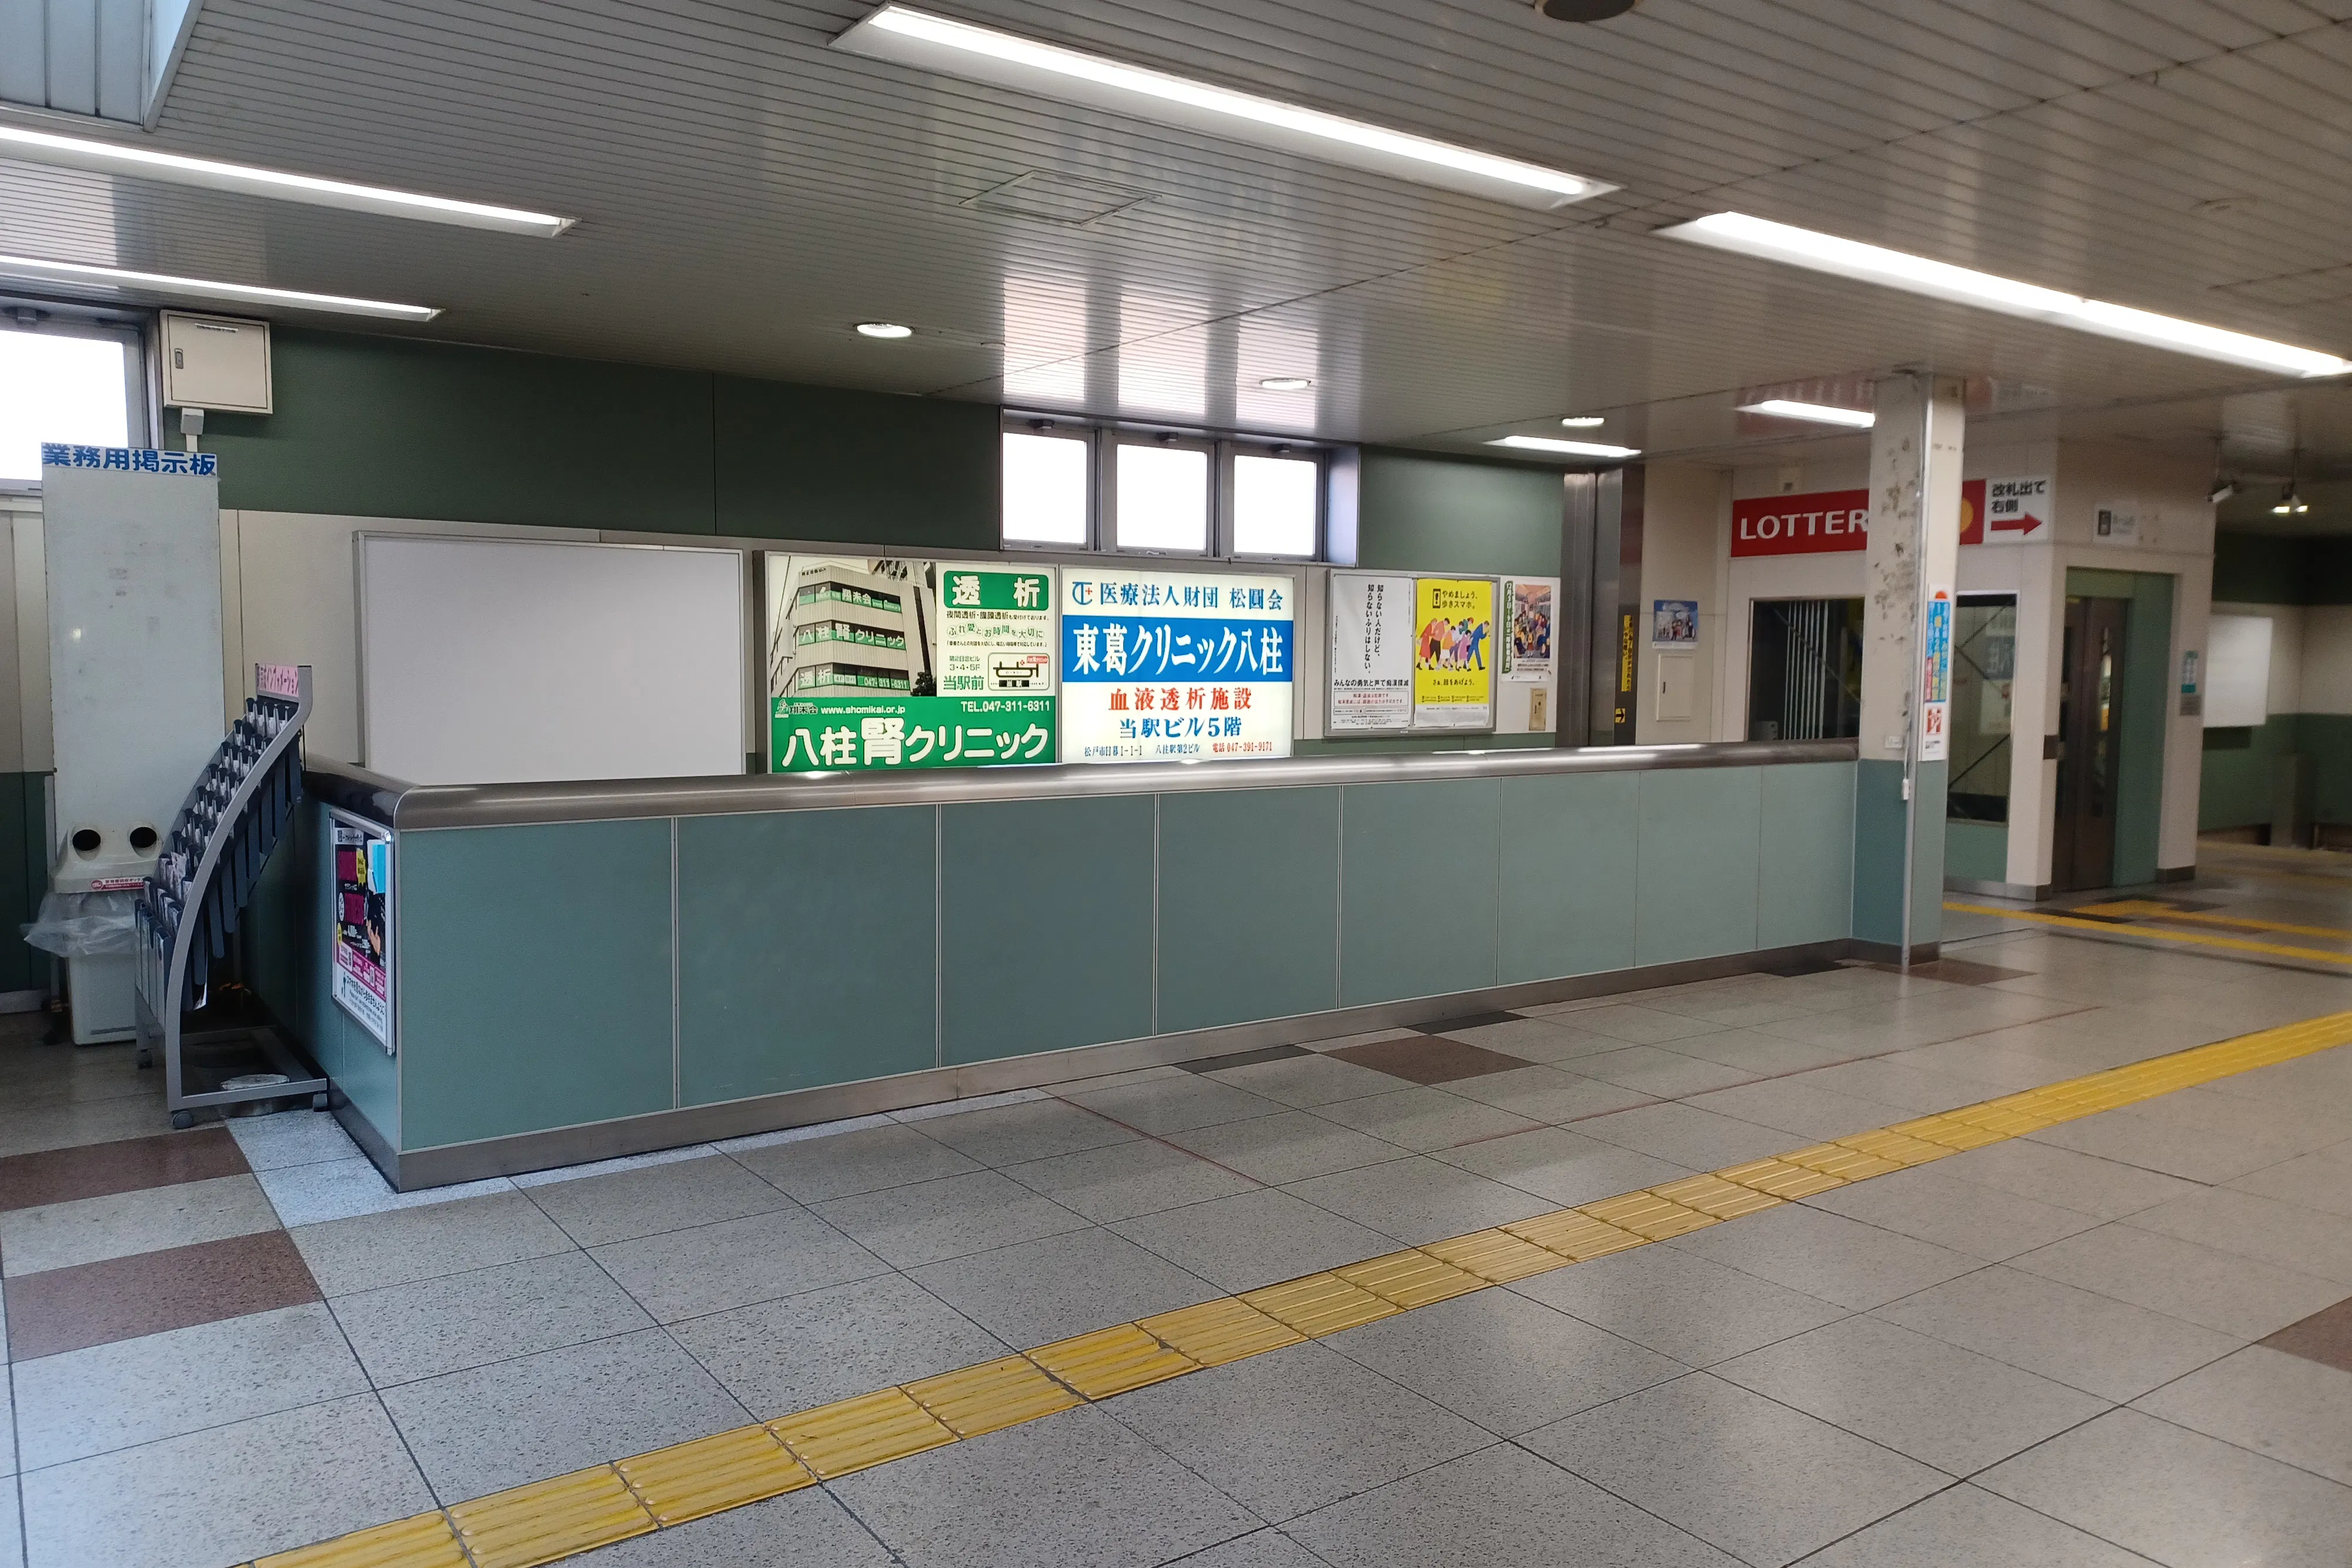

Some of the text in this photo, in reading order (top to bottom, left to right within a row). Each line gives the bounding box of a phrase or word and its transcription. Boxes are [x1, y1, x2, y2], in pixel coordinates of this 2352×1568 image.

[42, 444, 216, 476] 業務用掲示板
[1992, 480, 2046, 497] 改札出て
[1740, 509, 1869, 540] LOTTER
[1100, 582, 1219, 609] 医療法人財団
[1364, 584, 1374, 673] 知らないふりはしない。
[1374, 584, 1384, 656] 知らない人だけど、
[802, 623, 904, 646] 八柱腎クリニック
[1073, 623, 1283, 676] 東葛クリニック八柱
[944, 676, 984, 690] 当駅前
[961, 700, 1050, 713] TEL.047-311-6311
[1108, 687, 1252, 711] 血液透析施設
[1120, 717, 1242, 739] 当駅ビル5階
[782, 718, 1049, 767] 八柱腎クリニック
